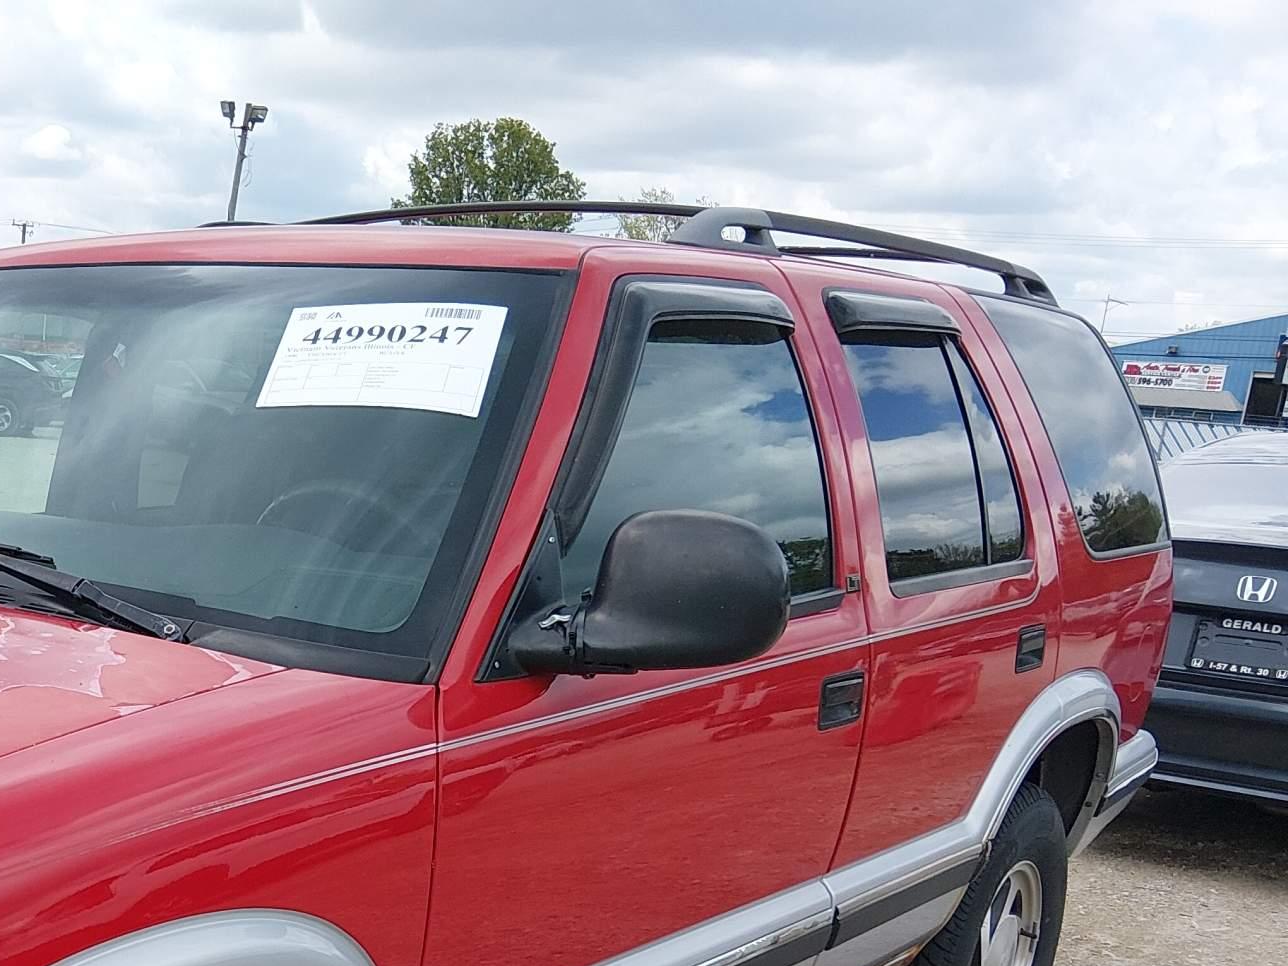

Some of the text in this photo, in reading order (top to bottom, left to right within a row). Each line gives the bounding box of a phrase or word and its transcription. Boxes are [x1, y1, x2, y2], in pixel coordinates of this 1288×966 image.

[302, 325, 474, 345] 44990247
[1222, 618, 1282, 634] GERALD
[1209, 661, 1228, 671] I-57
[1229, 664, 1238, 673] &
[1256, 668, 1270, 676] 30
